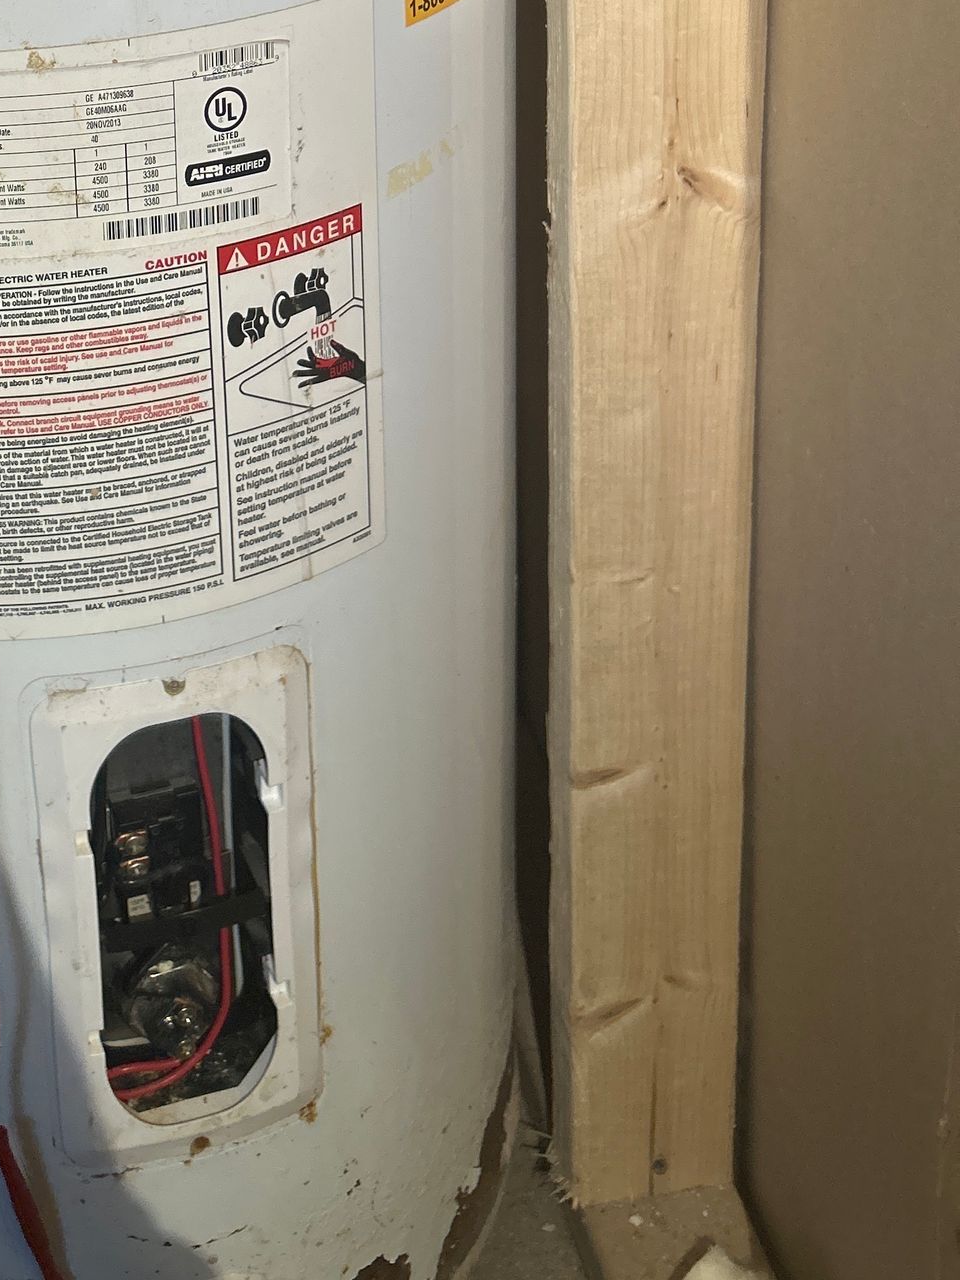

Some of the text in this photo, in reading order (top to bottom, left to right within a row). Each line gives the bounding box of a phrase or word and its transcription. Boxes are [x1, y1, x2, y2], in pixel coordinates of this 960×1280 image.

[85, 94, 93, 103] GE
[86, 119, 121, 130] 20NOV2013
[91, 135, 99, 143] 40
[214, 131, 239, 142] LISTED
[144, 143, 148, 151] 1
[94, 149, 98, 157] 1
[144, 156, 156, 165] 208
[94, 162, 107, 171] 240
[143, 169, 159, 179] 3380
[190, 164, 223, 182] AHRI
[92, 176, 108, 185] 4500
[7, 184, 25, 192] Watts
[143, 183, 159, 193] 3380
[201, 189, 215, 198] MADE
[223, 186, 233, 194] USA
[93, 190, 109, 199] 4500
[93, 203, 109, 212] 4500
[144, 197, 160, 207] 3380
[256, 213, 354, 261] DANGER
[145, 250, 208, 271] CAUTION
[35, 270, 69, 282] WATER
[70, 266, 108, 279] HEATER
[38, 289, 60, 298] Follow
[62, 287, 73, 295] the
[136, 277, 149, 285] Use
[150, 274, 162, 283] and
[163, 271, 179, 280] Care
[180, 267, 203, 277] Manual
[311, 320, 337, 340] HOT
[330, 360, 355, 378] BURN
[234, 435, 259, 448] Water
[260, 418, 309, 439] temperature
[310, 411, 327, 423] over
[329, 404, 342, 415] 125
[234, 406, 361, 458] can cause severe burns instantly
[235, 429, 363, 482] Children, disabled and elderly are
[235, 460, 245, 469] or
[246, 451, 270, 465] death
[272, 446, 290, 457] from
[85, 602, 106, 611] MAX.
[107, 596, 147, 608] WORKING
[148, 586, 191, 602] PRESSURE
[192, 584, 206, 593] 150
